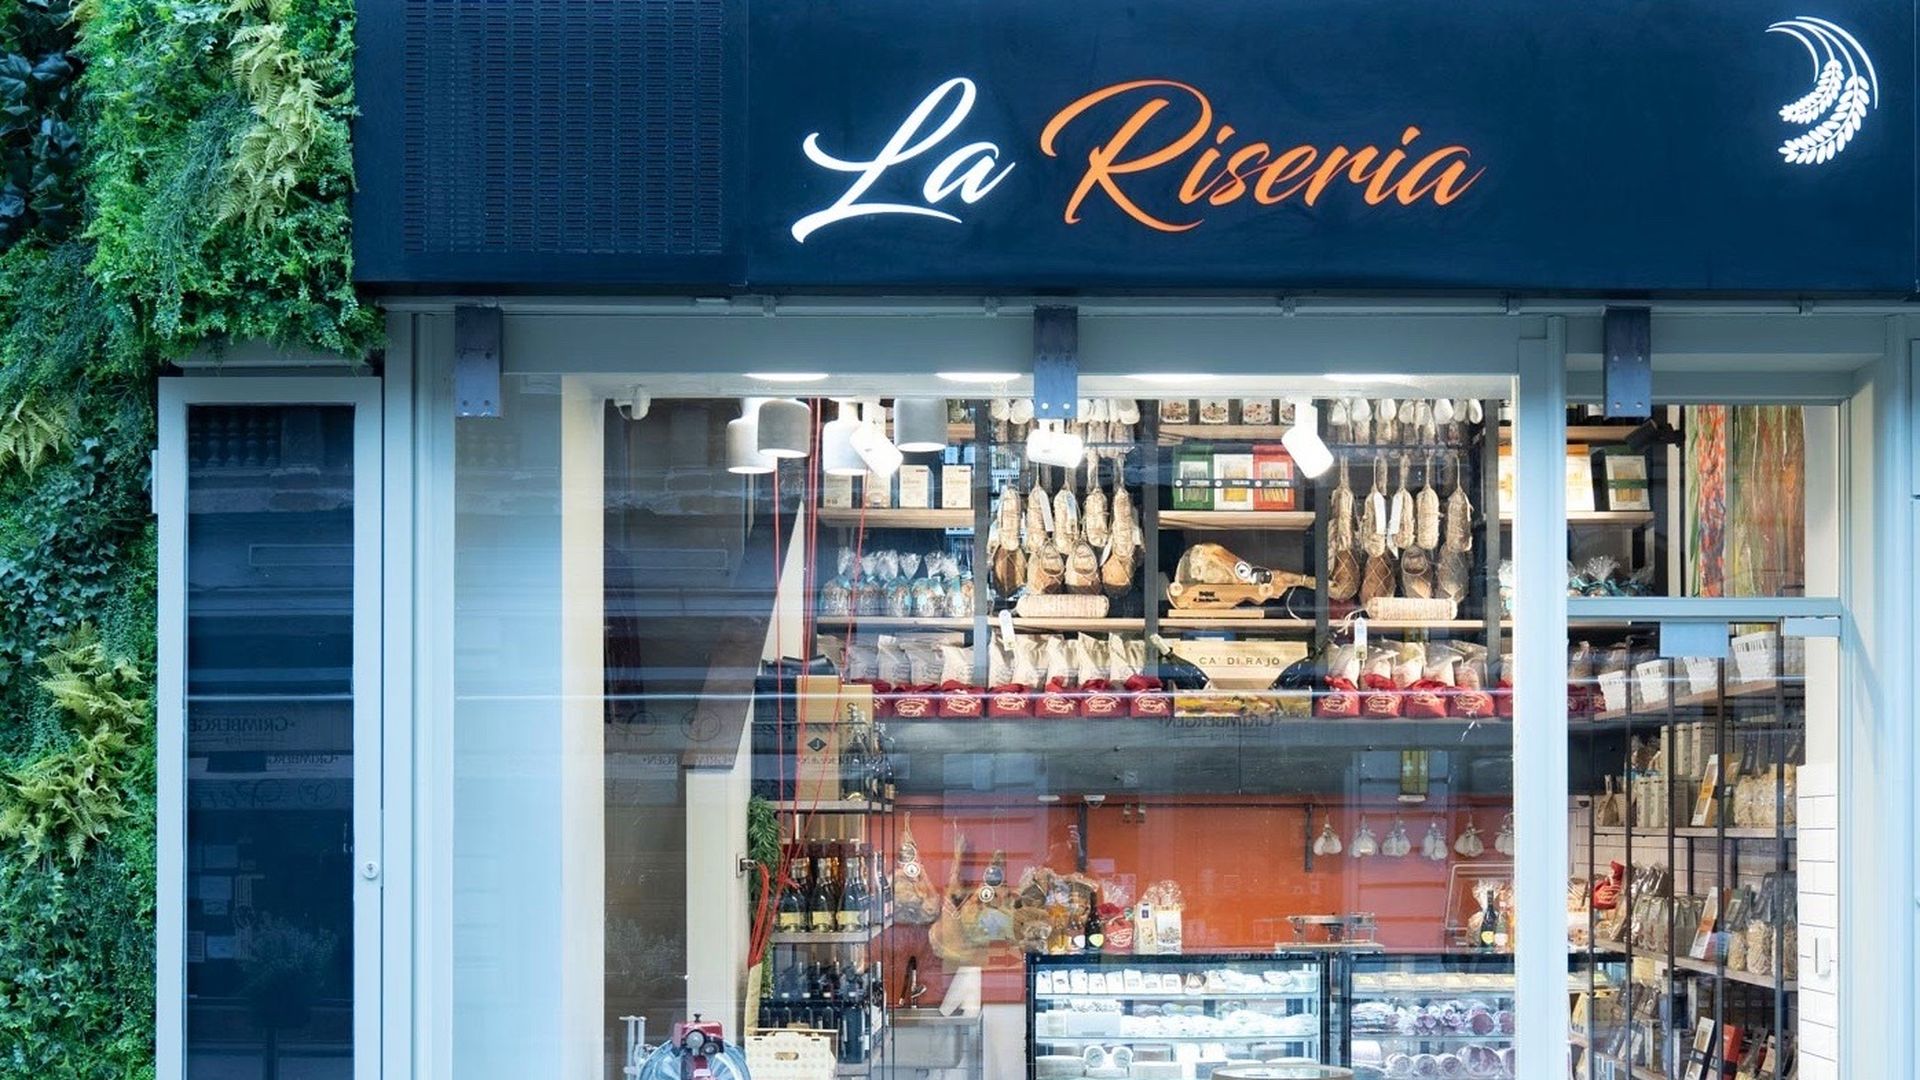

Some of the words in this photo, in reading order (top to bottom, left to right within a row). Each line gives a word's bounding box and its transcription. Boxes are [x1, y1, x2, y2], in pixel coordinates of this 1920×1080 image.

[791, 77, 1016, 243] La
[1040, 79, 1486, 232] Riseria
[1227, 657, 1240, 665] DI
[1246, 657, 1280, 666] RAJO
